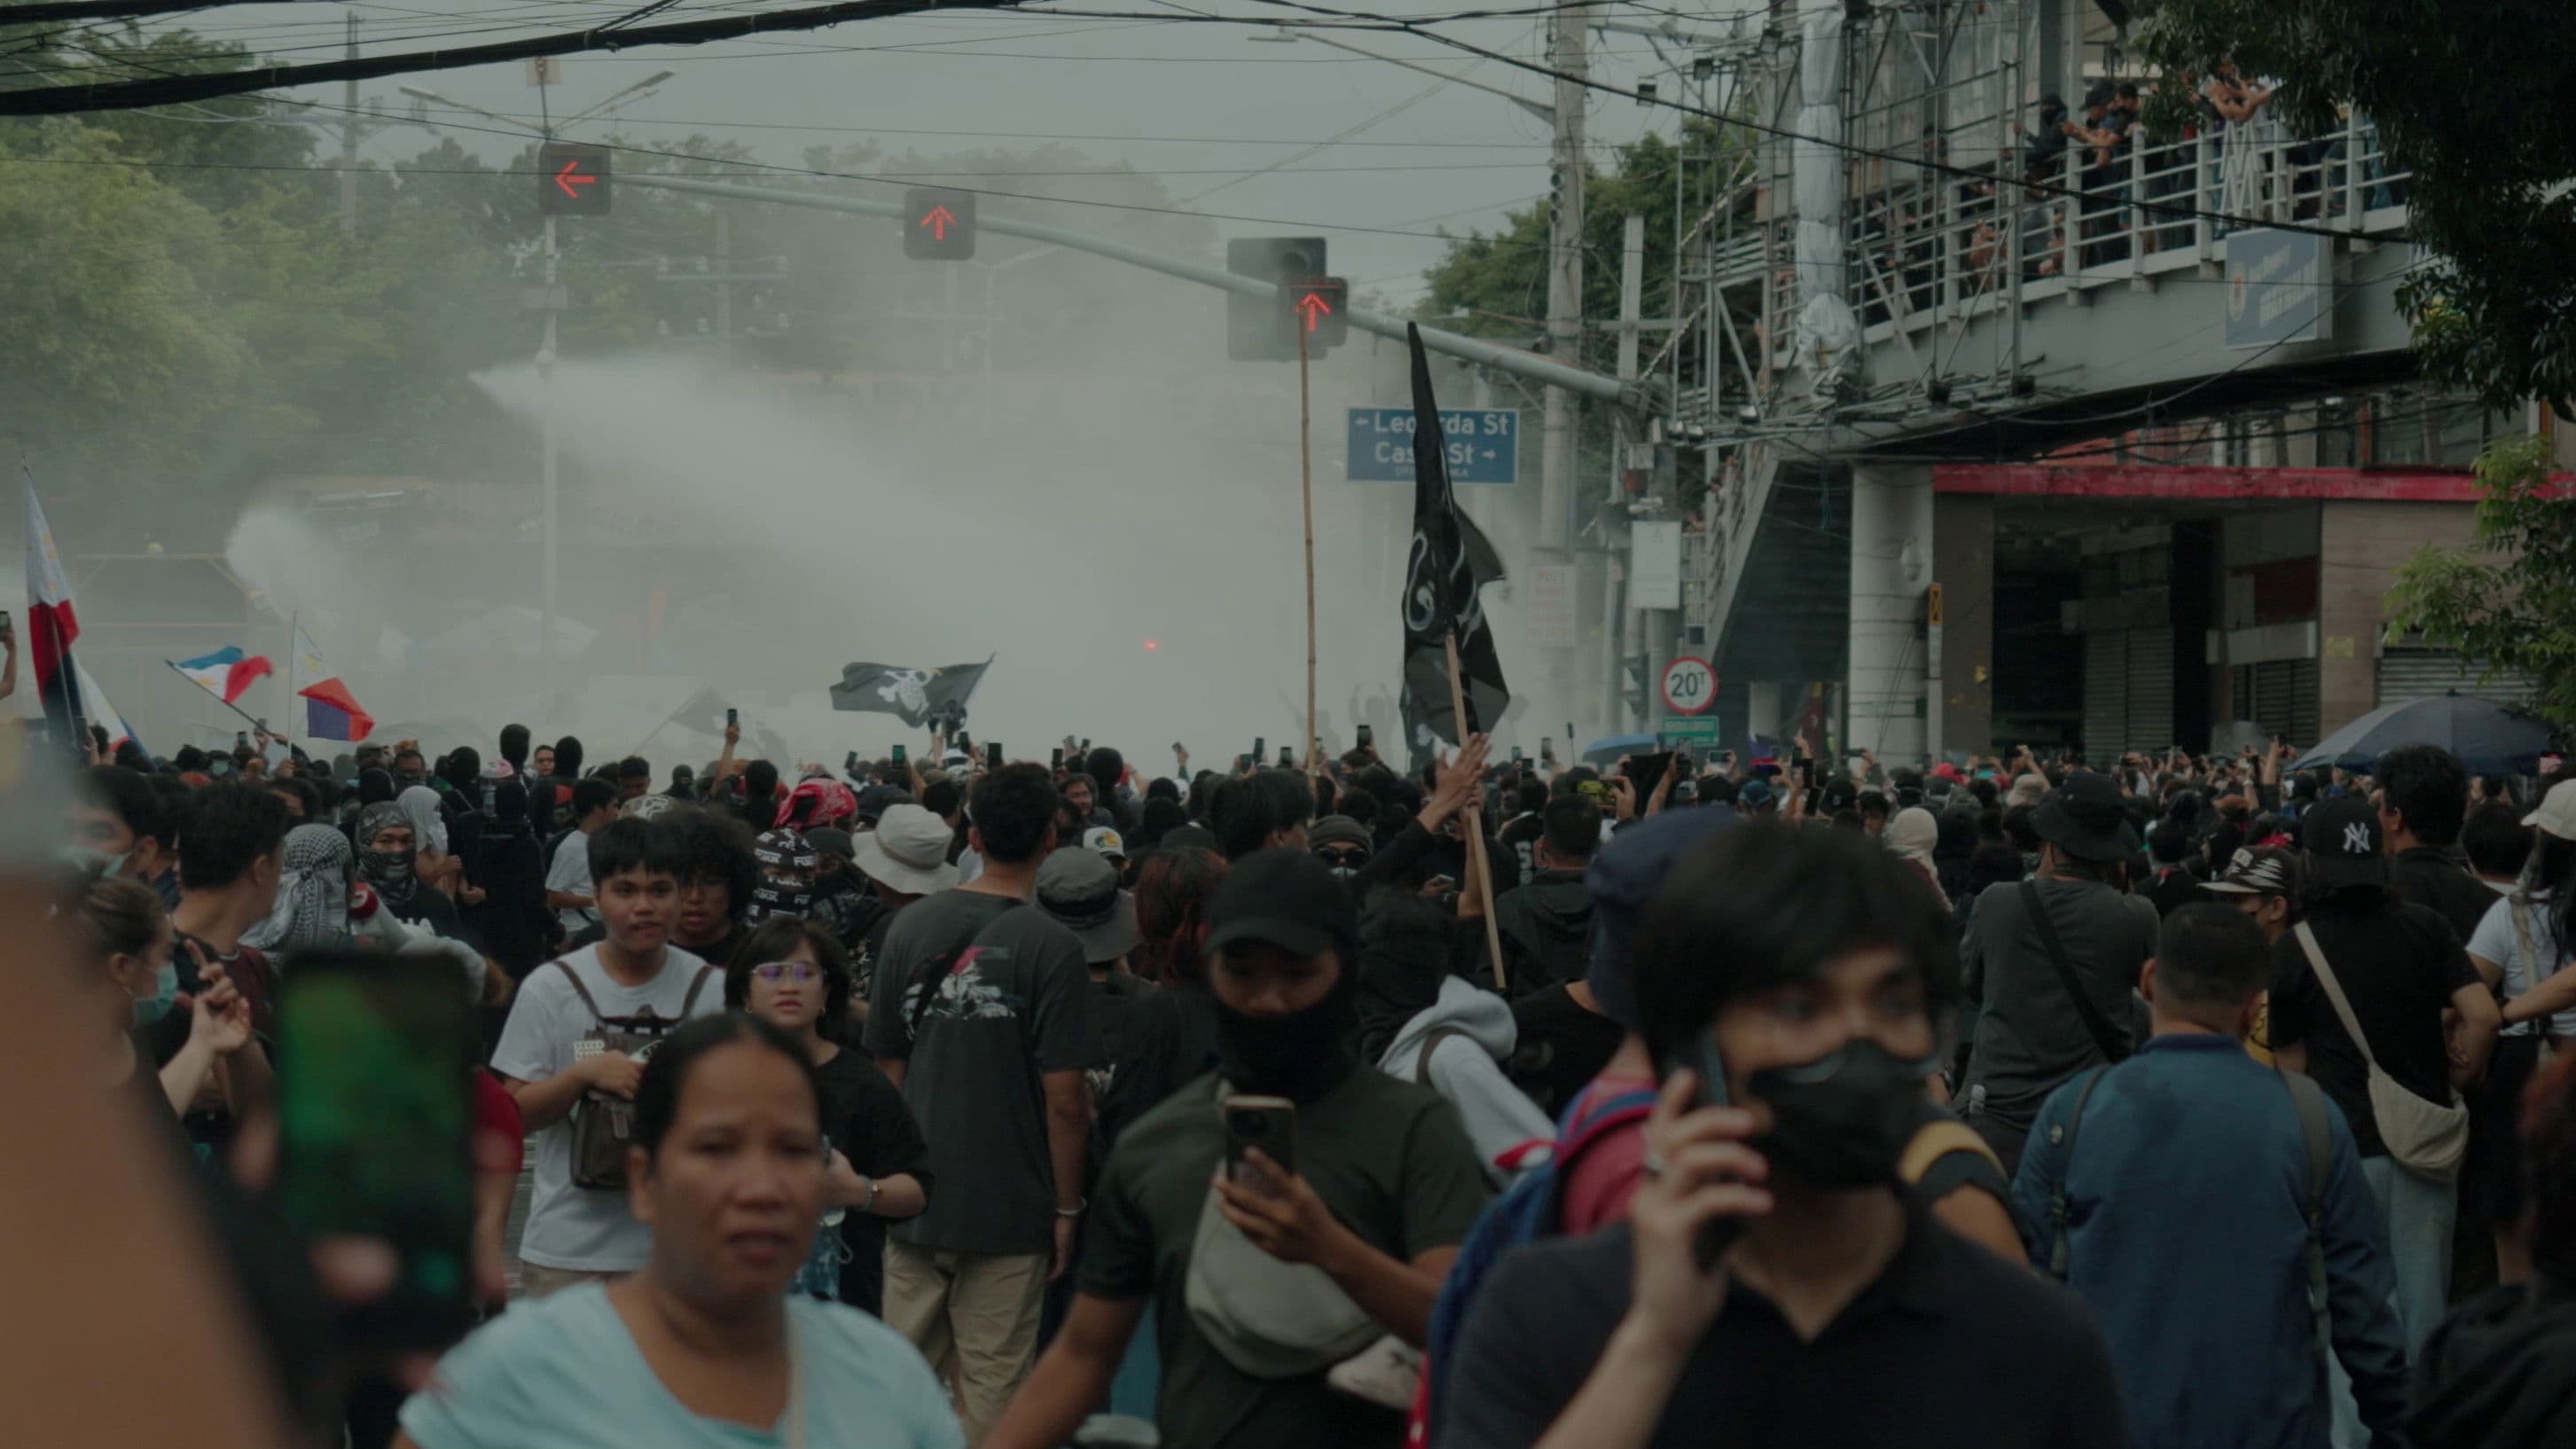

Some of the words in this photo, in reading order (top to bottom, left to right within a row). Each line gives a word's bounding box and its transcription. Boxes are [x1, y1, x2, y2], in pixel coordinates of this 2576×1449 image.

[1483, 413, 1508, 435] St
[1448, 444, 1474, 465] St
[2342, 822, 2371, 853] NY
